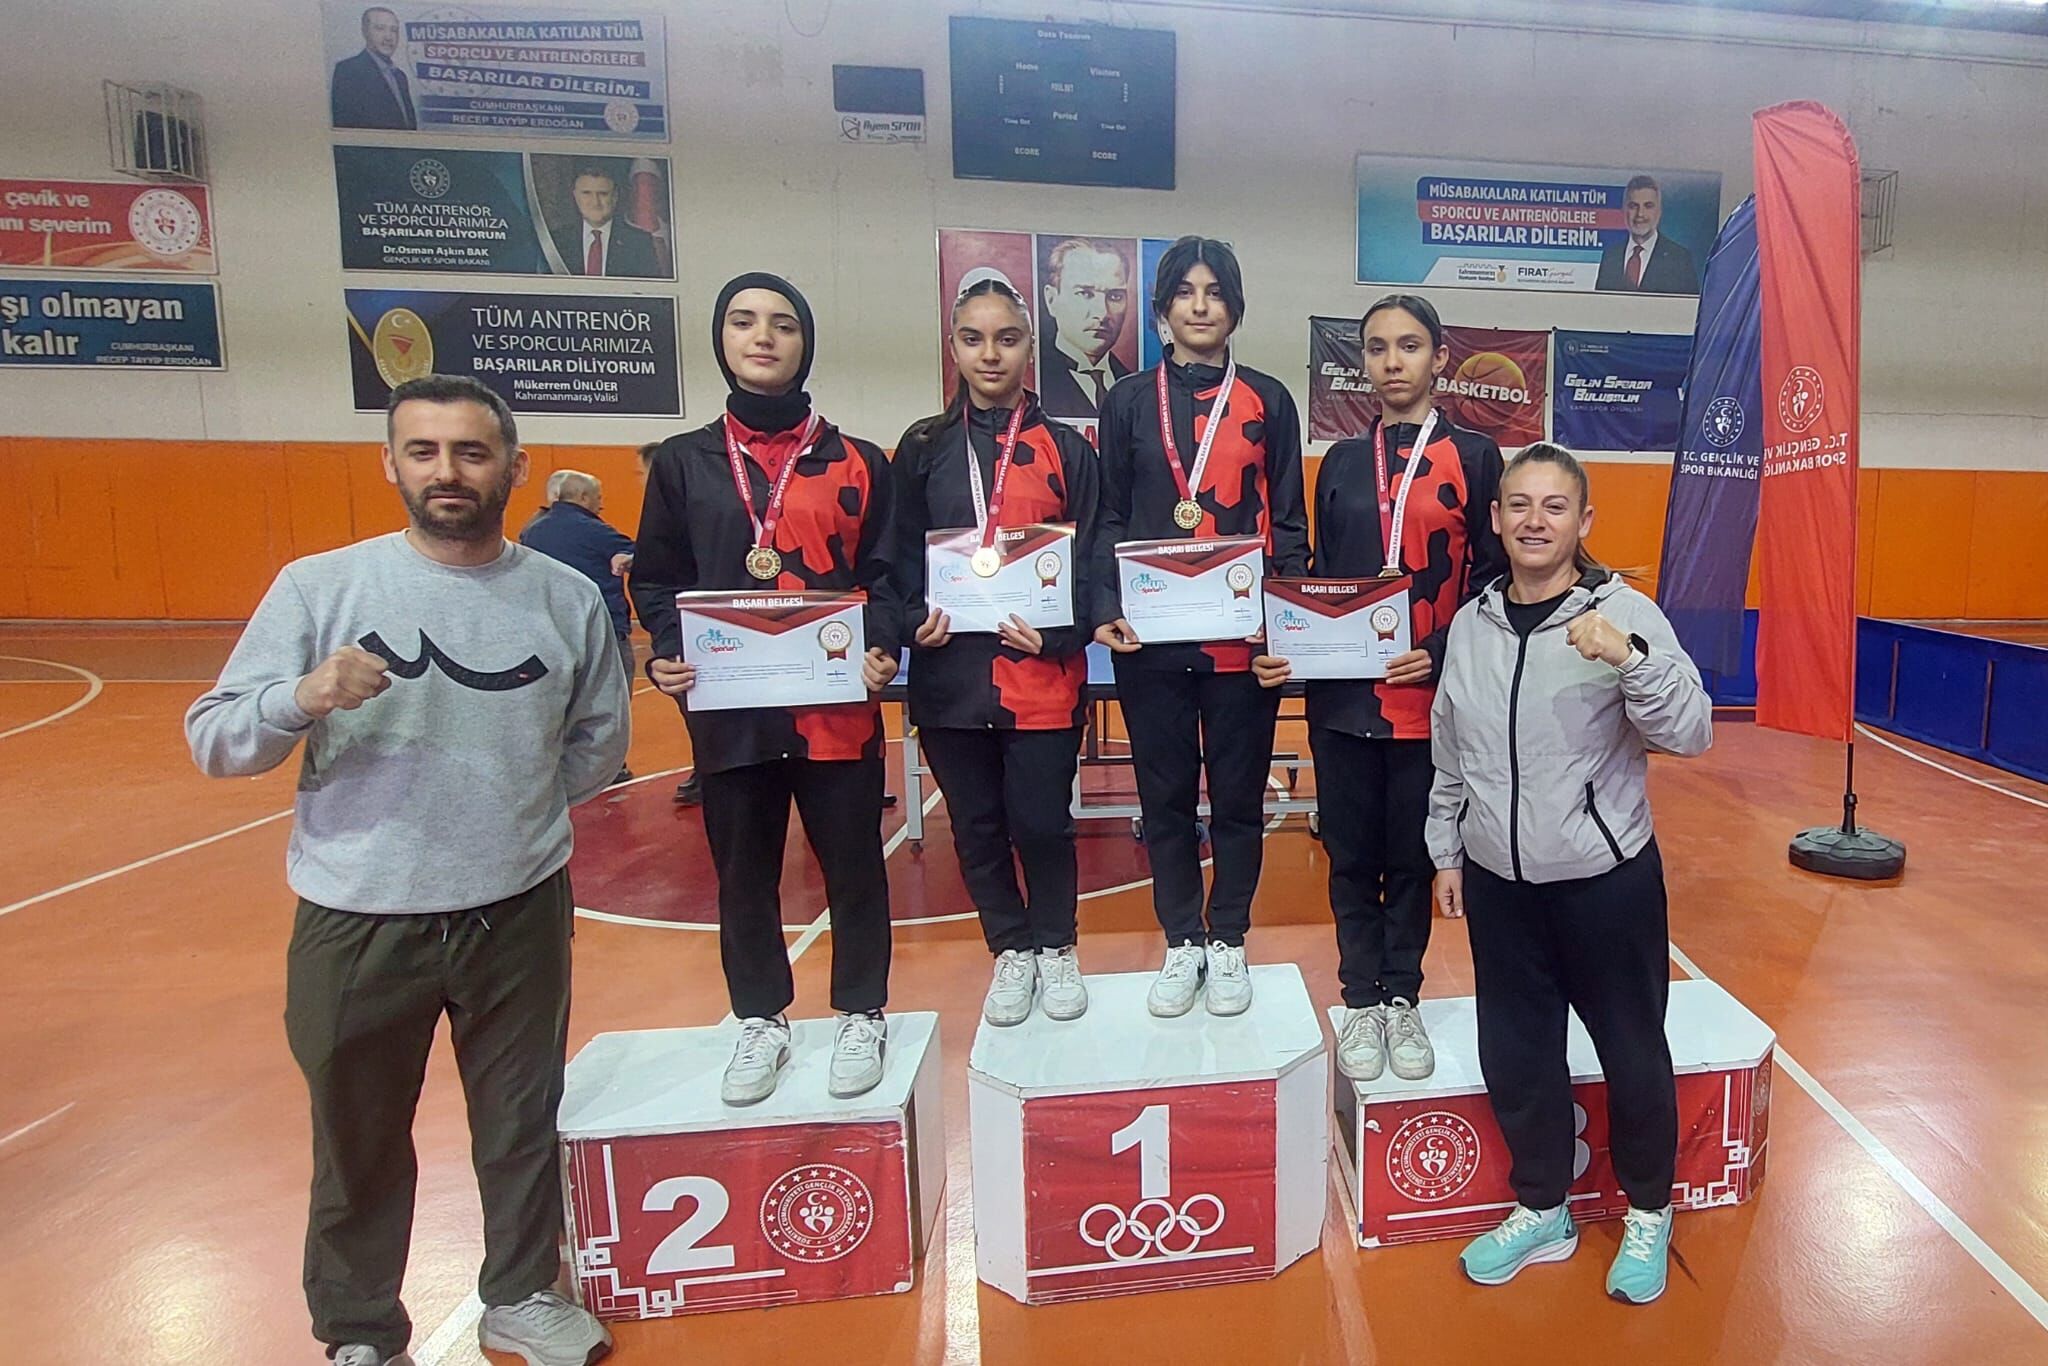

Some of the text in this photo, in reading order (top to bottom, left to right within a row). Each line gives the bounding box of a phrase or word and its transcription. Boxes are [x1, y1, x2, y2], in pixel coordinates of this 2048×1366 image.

[411, 24, 639, 41] MÜSABAKALARA KATILAN TÜM
[426, 46, 639, 66] SPORCU VE ANTRENÖRLERE
[429, 66, 641, 97] BAŞARILAR DİLERİM.
[470, 100, 565, 113] CUMHURBAŞKANI
[453, 114, 584, 129] RECEP TAYYİP ERDOĞAN
[1052, 112, 1078, 121] Period
[1014, 147, 1040, 156] SCORE
[1092, 151, 1118, 161] SCORE
[5, 190, 90, 209] çevik ve
[1429, 184, 1606, 205] MÜSABAKALARA KATILAN TÜM
[375, 202, 491, 217] TÜM ANTRENÖR
[1432, 206, 1596, 225] SPORCU VE ANTRENÖRLERE
[29, 217, 112, 234] severim
[359, 213, 509, 229] VE SPORCULARIMIZA
[362, 226, 507, 241] BAŞARILAR DİLİYORUM
[1431, 223, 1603, 247] BAŞARILAR DİLERİM.
[437, 246, 466, 257] Aşkın
[467, 247, 489, 257] BAK
[434, 257, 456, 266] SPOR
[1518, 267, 1548, 277] FIRAT
[41, 291, 183, 325] olmayan
[471, 306, 650, 331] TÜM ANTRENÖR
[2, 329, 79, 355] kalır
[472, 334, 653, 354] VE SPORCULARIMIZA
[473, 357, 655, 374] BAŞARILAR DİLİYORUM
[513, 379, 618, 392] Mükerrem ÜNLÜER
[1437, 377, 1532, 405] BASKETBOL
[515, 391, 618, 404] Kahramanmaraş Valisi
[1683, 451, 1698, 461] T.C.
[1747, 455, 1760, 466] VE
[1680, 463, 1705, 476] SPOR
[998, 530, 1025, 541] BELGESİ
[1158, 543, 1214, 556] BAŞARI BELGESİ
[1301, 584, 1357, 595] BAŞARI BELGESİ
[732, 597, 803, 609] BAŞARI BELGESİ
[1111, 1103, 1171, 1200] 1
[641, 1175, 736, 1276] 2
